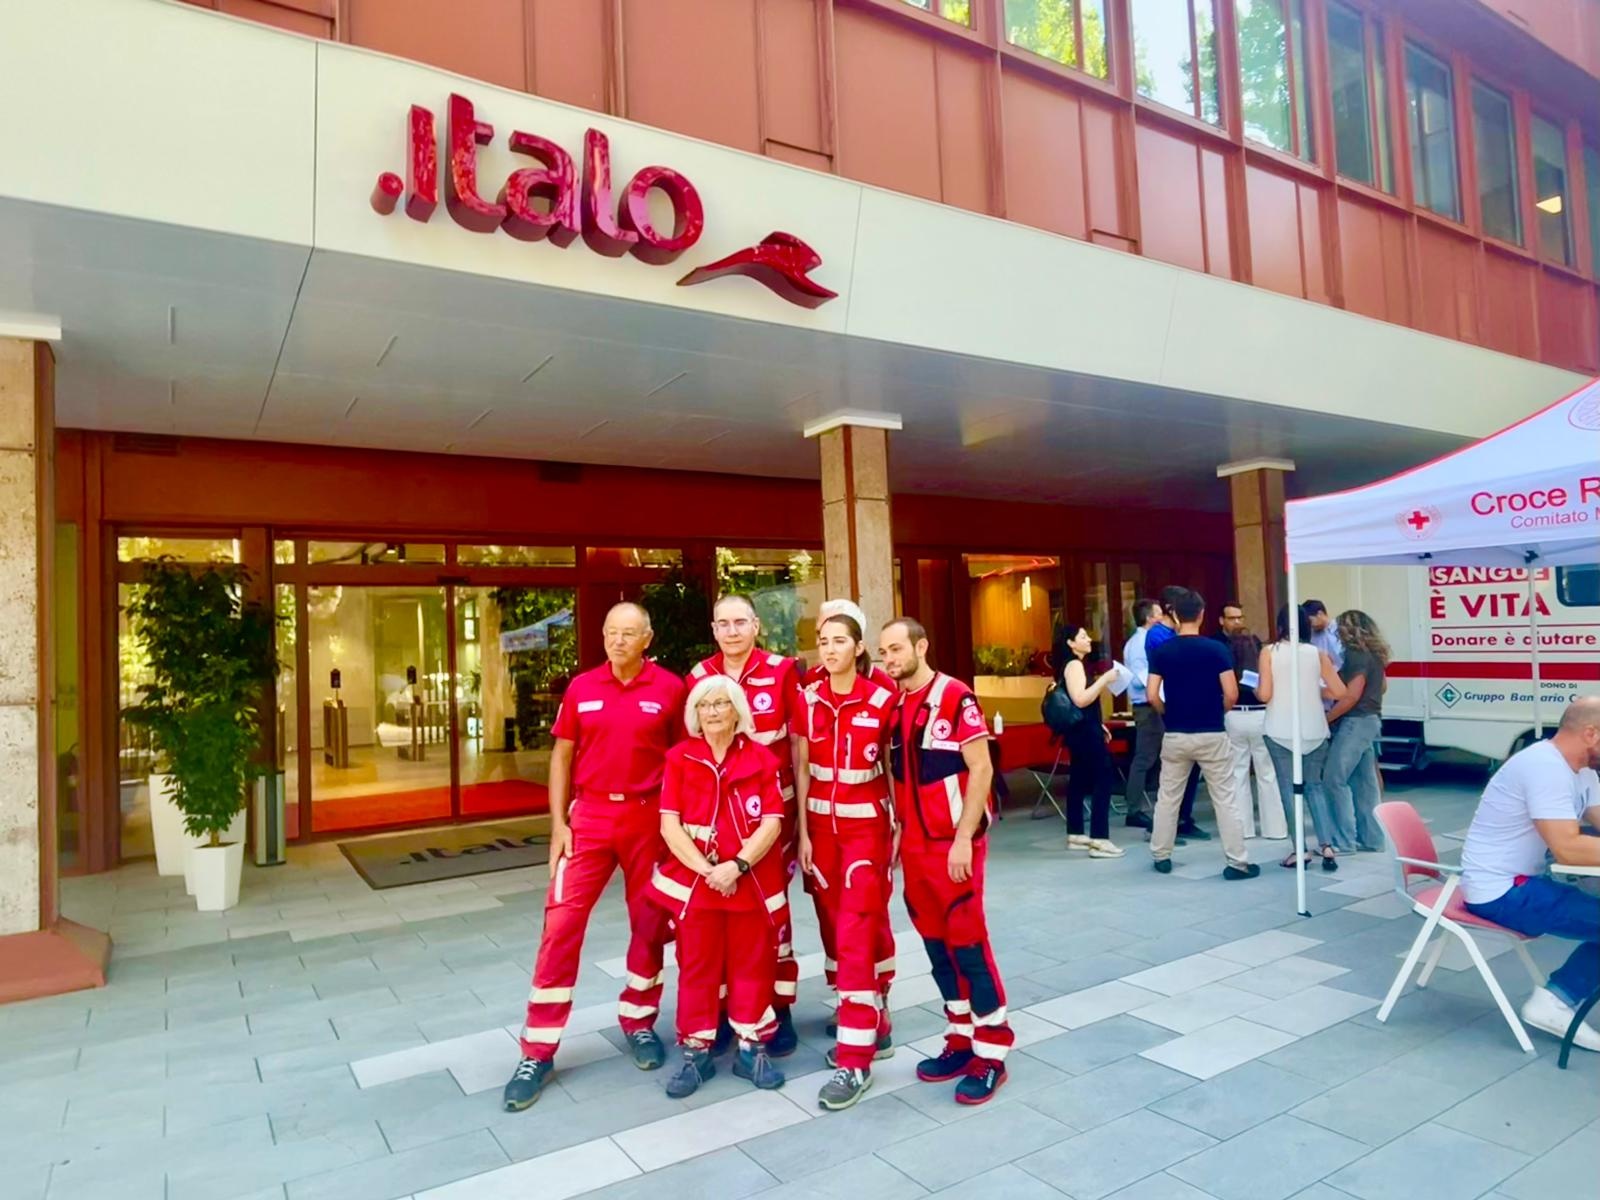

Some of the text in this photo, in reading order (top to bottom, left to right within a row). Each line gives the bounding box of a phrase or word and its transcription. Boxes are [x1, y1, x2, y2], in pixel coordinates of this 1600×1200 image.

[1470, 488, 1568, 516] Croce
[1510, 511, 1589, 529] Comitato
[1433, 566, 1546, 585] SANGUE
[1429, 588, 1552, 619] È VITA
[1431, 633, 1498, 646] Donare
[1504, 631, 1516, 646] è
[1464, 691, 1505, 703] Gruppo
[1510, 692, 1565, 703] Banario
